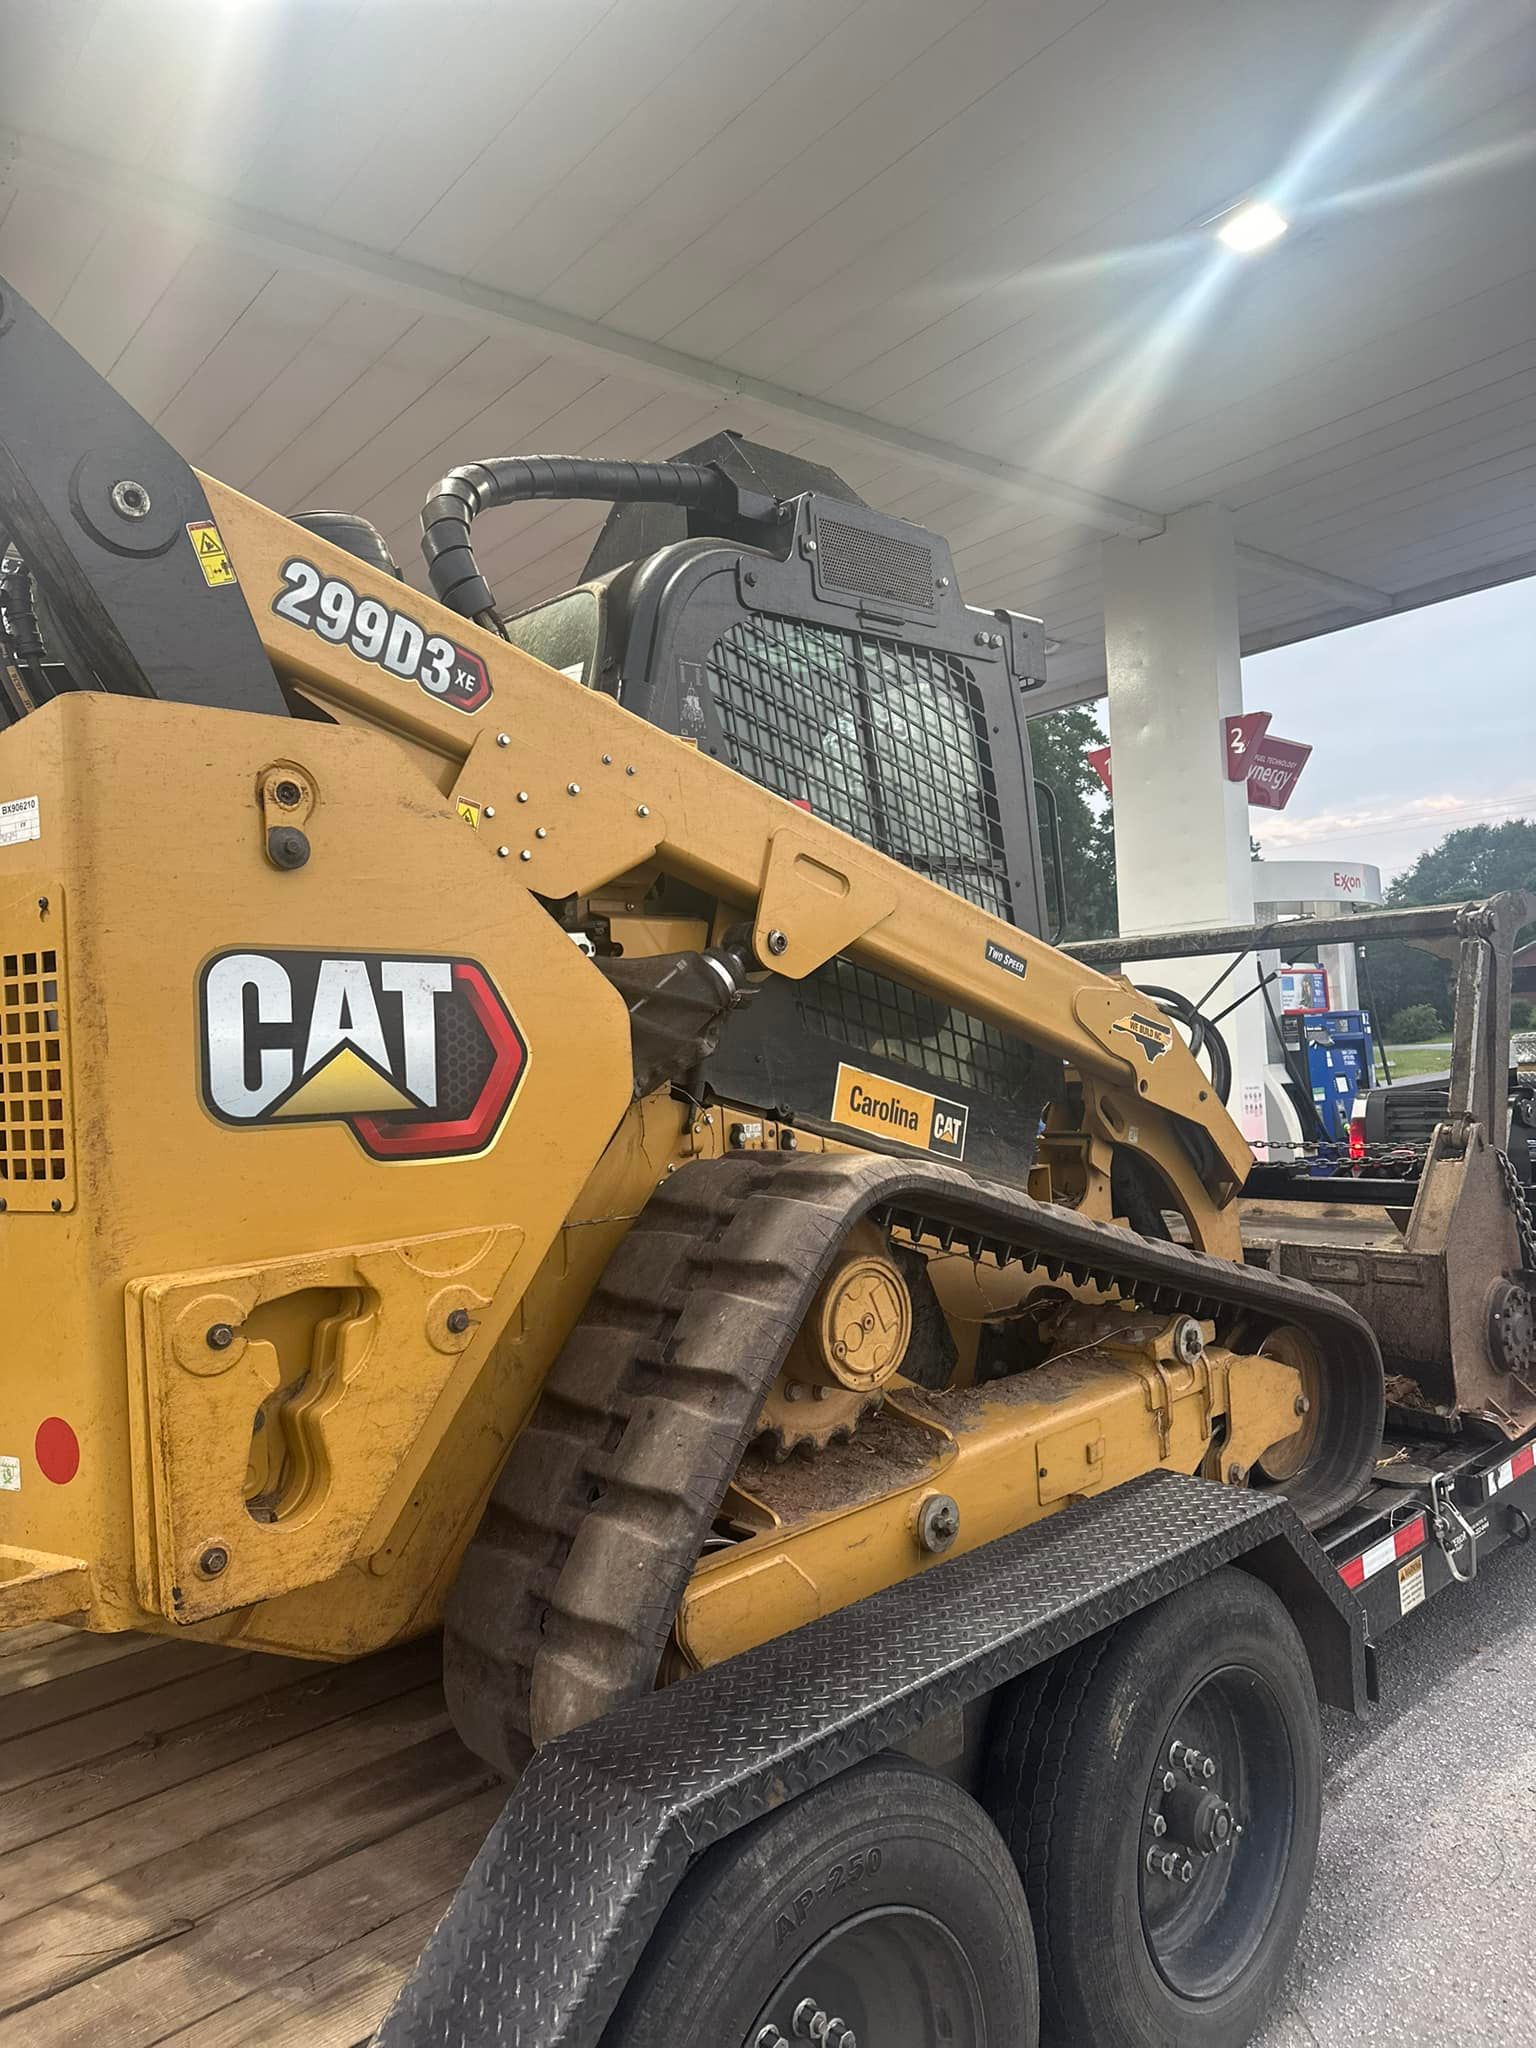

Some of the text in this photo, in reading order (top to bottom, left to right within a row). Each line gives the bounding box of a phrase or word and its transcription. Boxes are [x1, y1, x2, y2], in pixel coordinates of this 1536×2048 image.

[277, 562, 476, 693] 299D3 XE
[1246, 764, 1293, 791] ynergy
[1267, 756, 1298, 769] TECHNOLOGY
[1, 799, 36, 815] BX906210
[1333, 872, 1361, 893] Exxon
[206, 953, 453, 1118] CAT
[849, 1085, 919, 1131] Carolina
[934, 1112, 962, 1144] CAT
[775, 1846, 882, 1952] AP-250
